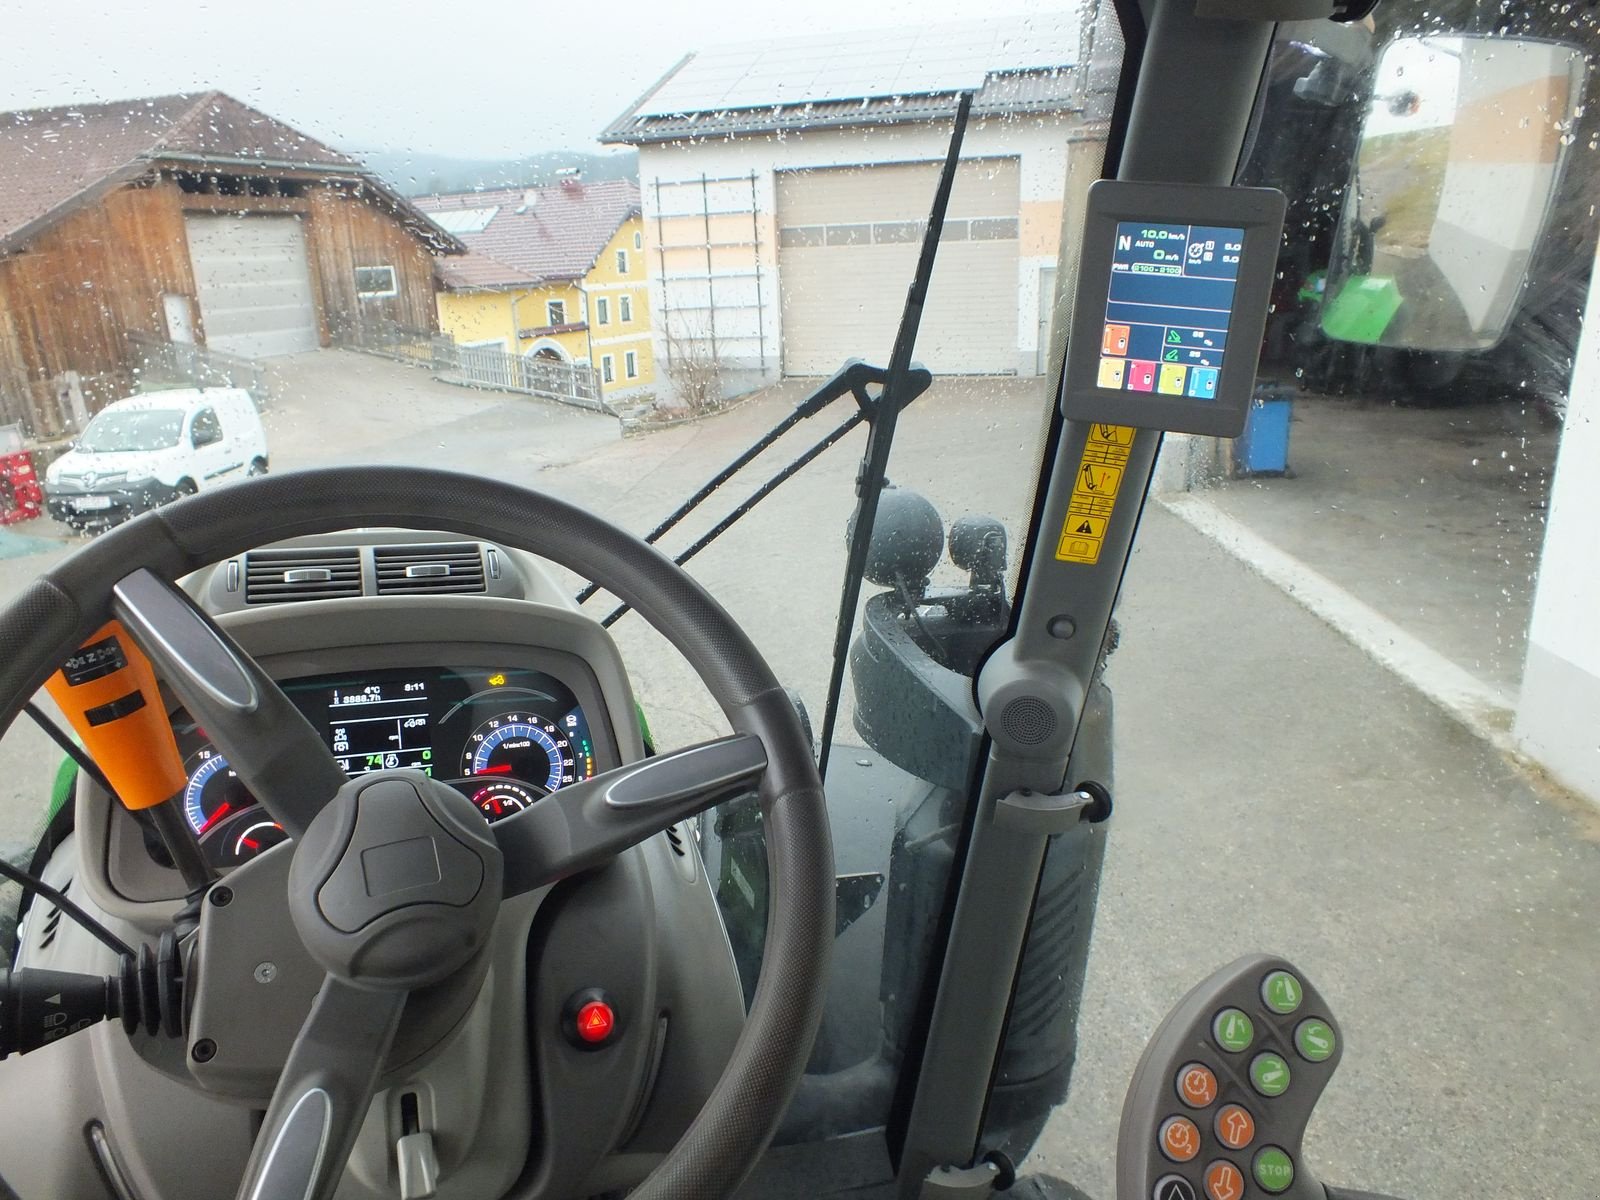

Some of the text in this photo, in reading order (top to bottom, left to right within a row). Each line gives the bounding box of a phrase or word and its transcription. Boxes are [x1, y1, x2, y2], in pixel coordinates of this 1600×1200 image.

[1141, 229, 1168, 240] 10.0
[1118, 235, 1131, 251] N
[1135, 240, 1155, 248] AUTO
[1153, 249, 1165, 260] 0
[488, 720, 499, 728] 12
[544, 725, 555, 733] 18
[473, 734, 484, 742] 10
[557, 740, 568, 748] 20
[198, 750, 211, 759] 15
[422, 750, 432, 760] 0
[465, 752, 472, 760] 8
[366, 754, 382, 766] 74
[464, 768, 471, 776] 5
[562, 775, 573, 783] 25
[1204, 1091, 1210, 1101] 1
[1185, 1144, 1192, 1154] 2
[1259, 1165, 1291, 1177] STOP
